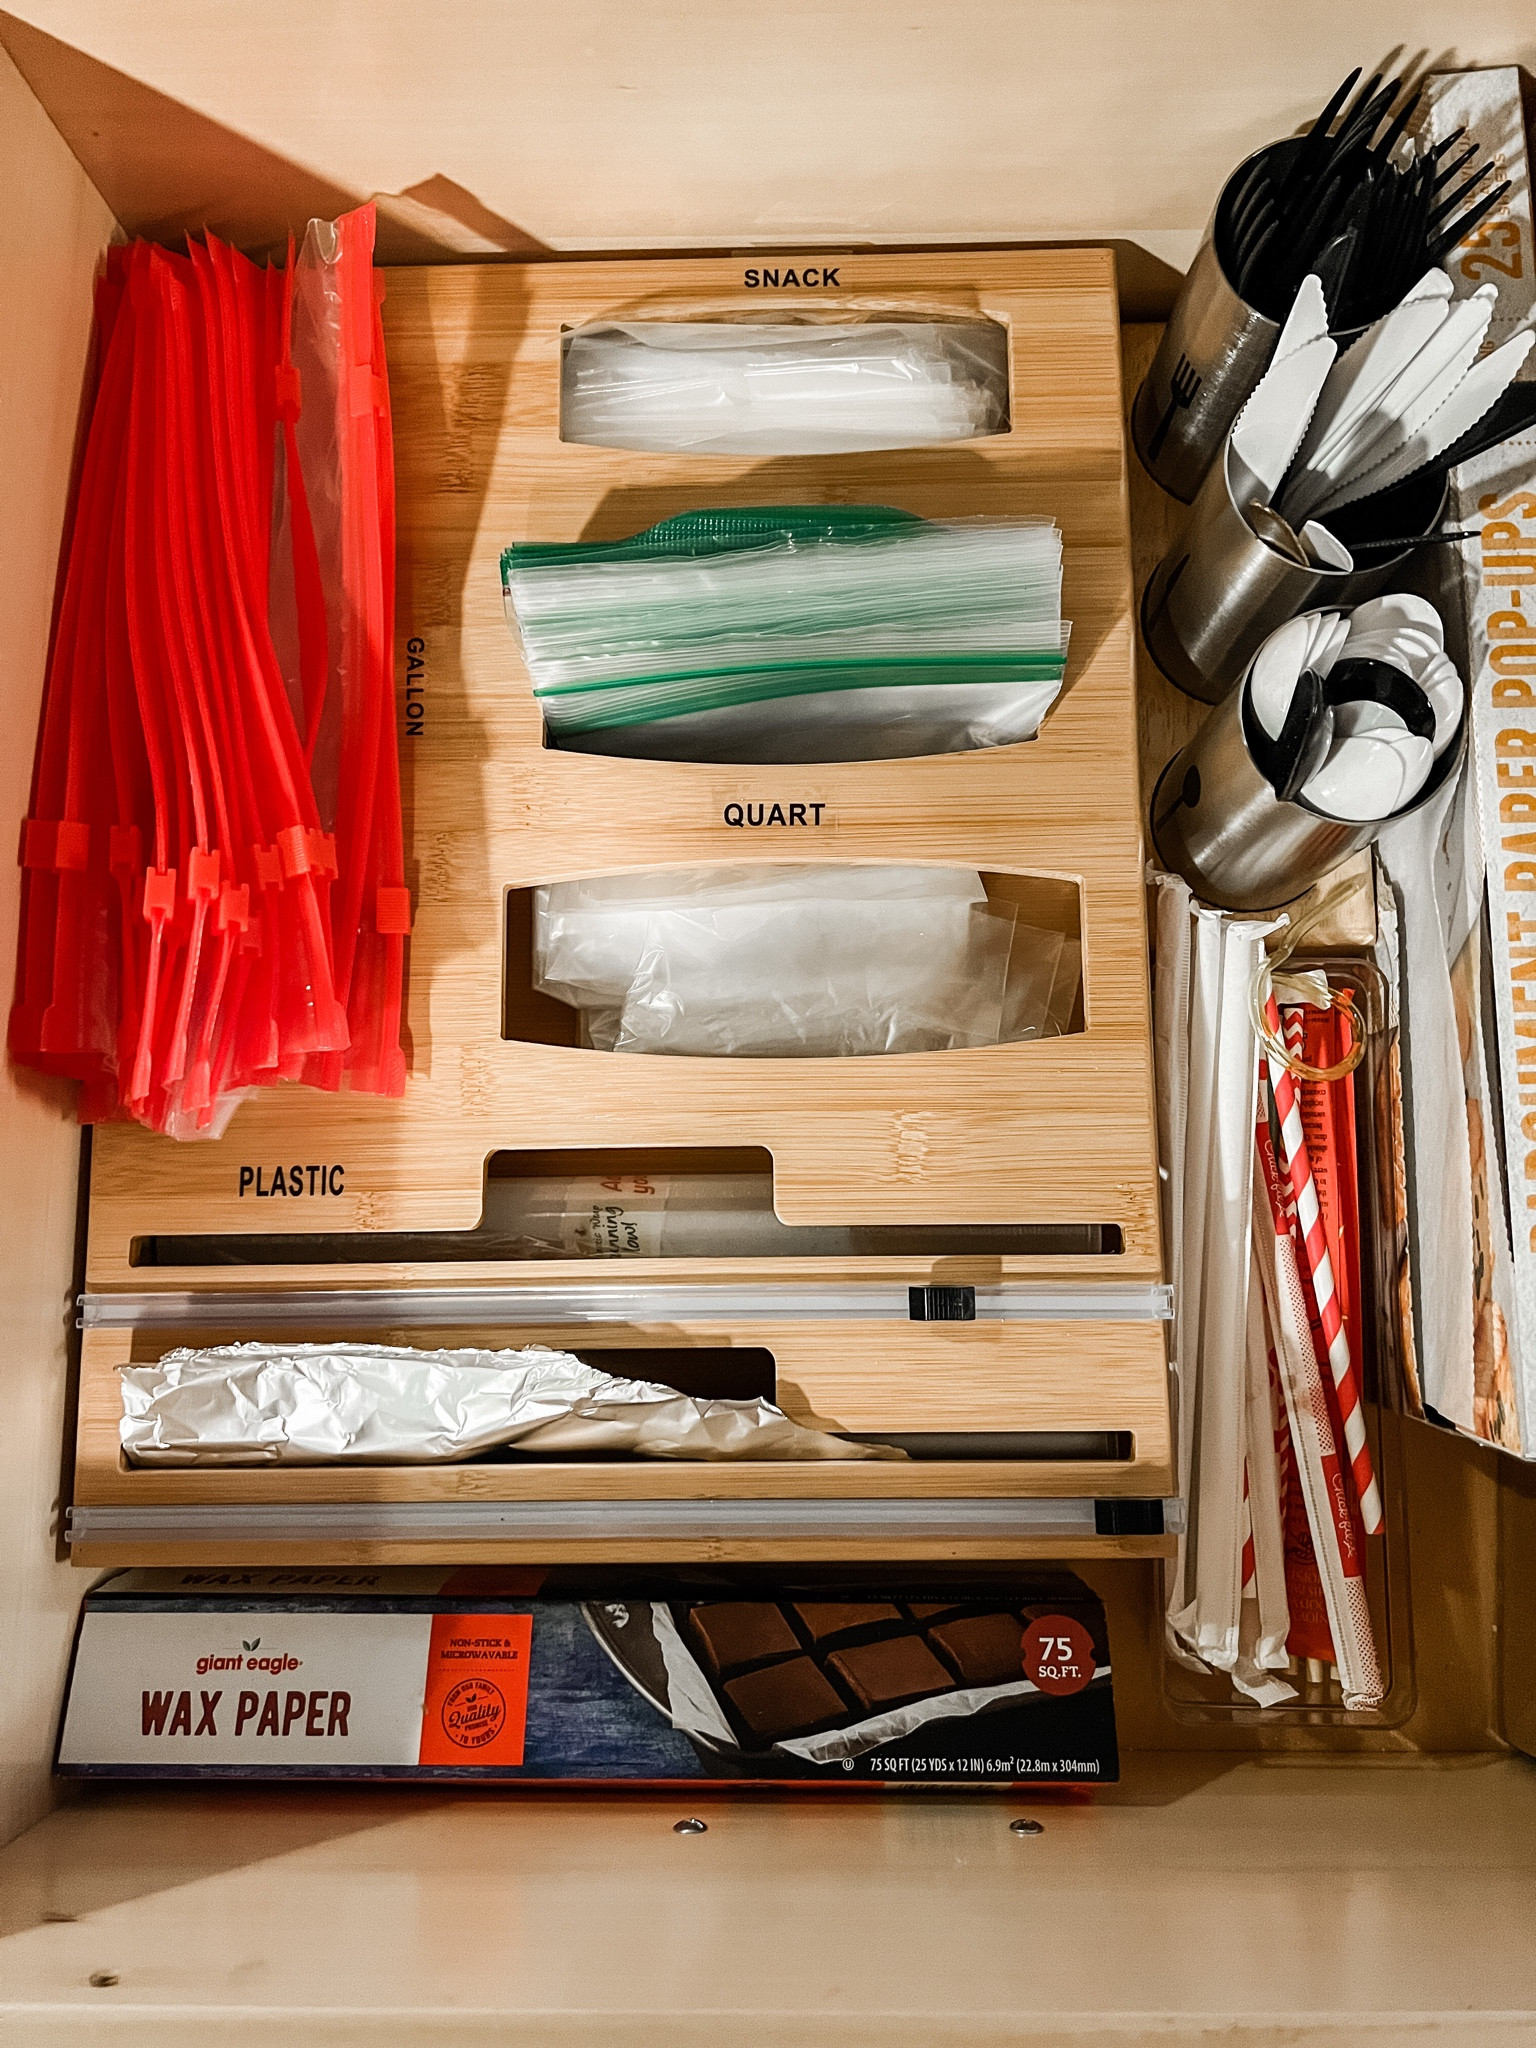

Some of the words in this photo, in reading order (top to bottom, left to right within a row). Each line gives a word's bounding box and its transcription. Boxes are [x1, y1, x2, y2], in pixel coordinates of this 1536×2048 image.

[1460, 221, 1524, 280] 25
[744, 268, 840, 288] SNACK
[1478, 492, 1536, 708] POP-UPS
[405, 637, 425, 736] GALLON
[723, 803, 826, 828] QUART
[239, 1164, 345, 1197] PLASTIC
[620, 1221, 640, 1252] low!
[181, 1573, 262, 1585] WAX
[267, 1574, 382, 1586] PAPER
[441, 1650, 518, 1660] MICROWAVABLE
[450, 1639, 502, 1648] NON-STICK
[1039, 1637, 1073, 1661] 75
[195, 1654, 243, 1675] giant
[246, 1653, 300, 1675] eagle
[1038, 1665, 1082, 1680] SQ.FT.
[142, 1691, 223, 1736] WAX
[234, 1691, 352, 1737] PAPER
[448, 1704, 501, 1729] Quality
[870, 1758, 882, 1771] 75
[884, 1758, 897, 1773] SQ
[899, 1758, 910, 1771] FT
[911, 1757, 927, 1774] (25
[928, 1758, 947, 1772] YDS
[948, 1761, 955, 1771] x
[957, 1758, 969, 1772] 12
[970, 1757, 985, 1774] IN)
[1016, 1758, 1050, 1774] (22.8m
[1051, 1762, 1058, 1772] x
[1059, 1758, 1100, 1775] 304mm)
